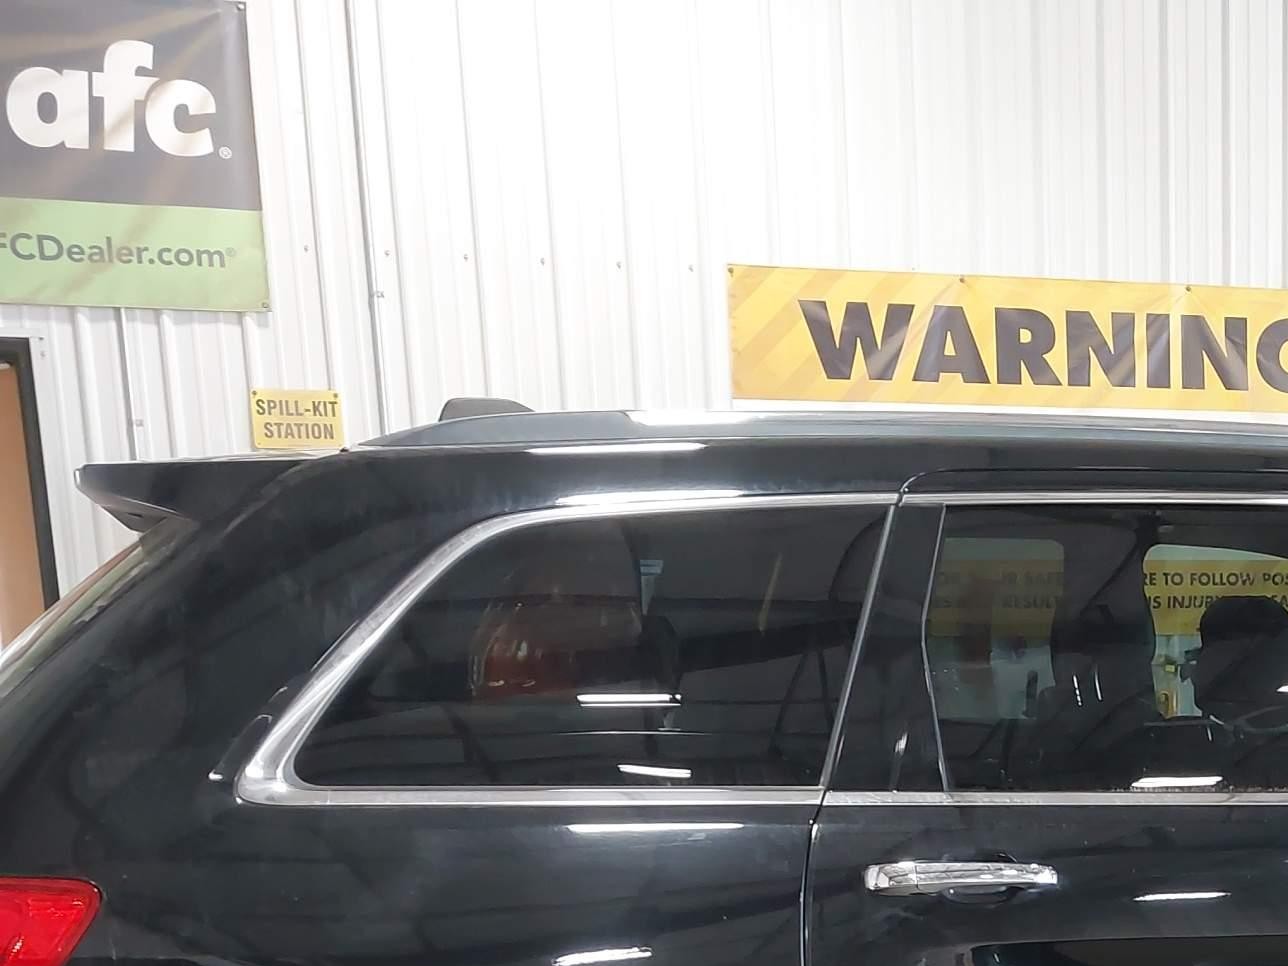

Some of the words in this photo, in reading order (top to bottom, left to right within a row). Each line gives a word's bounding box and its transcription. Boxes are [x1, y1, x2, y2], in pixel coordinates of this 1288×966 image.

[255, 399, 338, 417] SPILL-KIT
[263, 422, 335, 440] STATION
[1163, 572, 1184, 586] TO
[1190, 572, 1255, 586] FOLLOW
